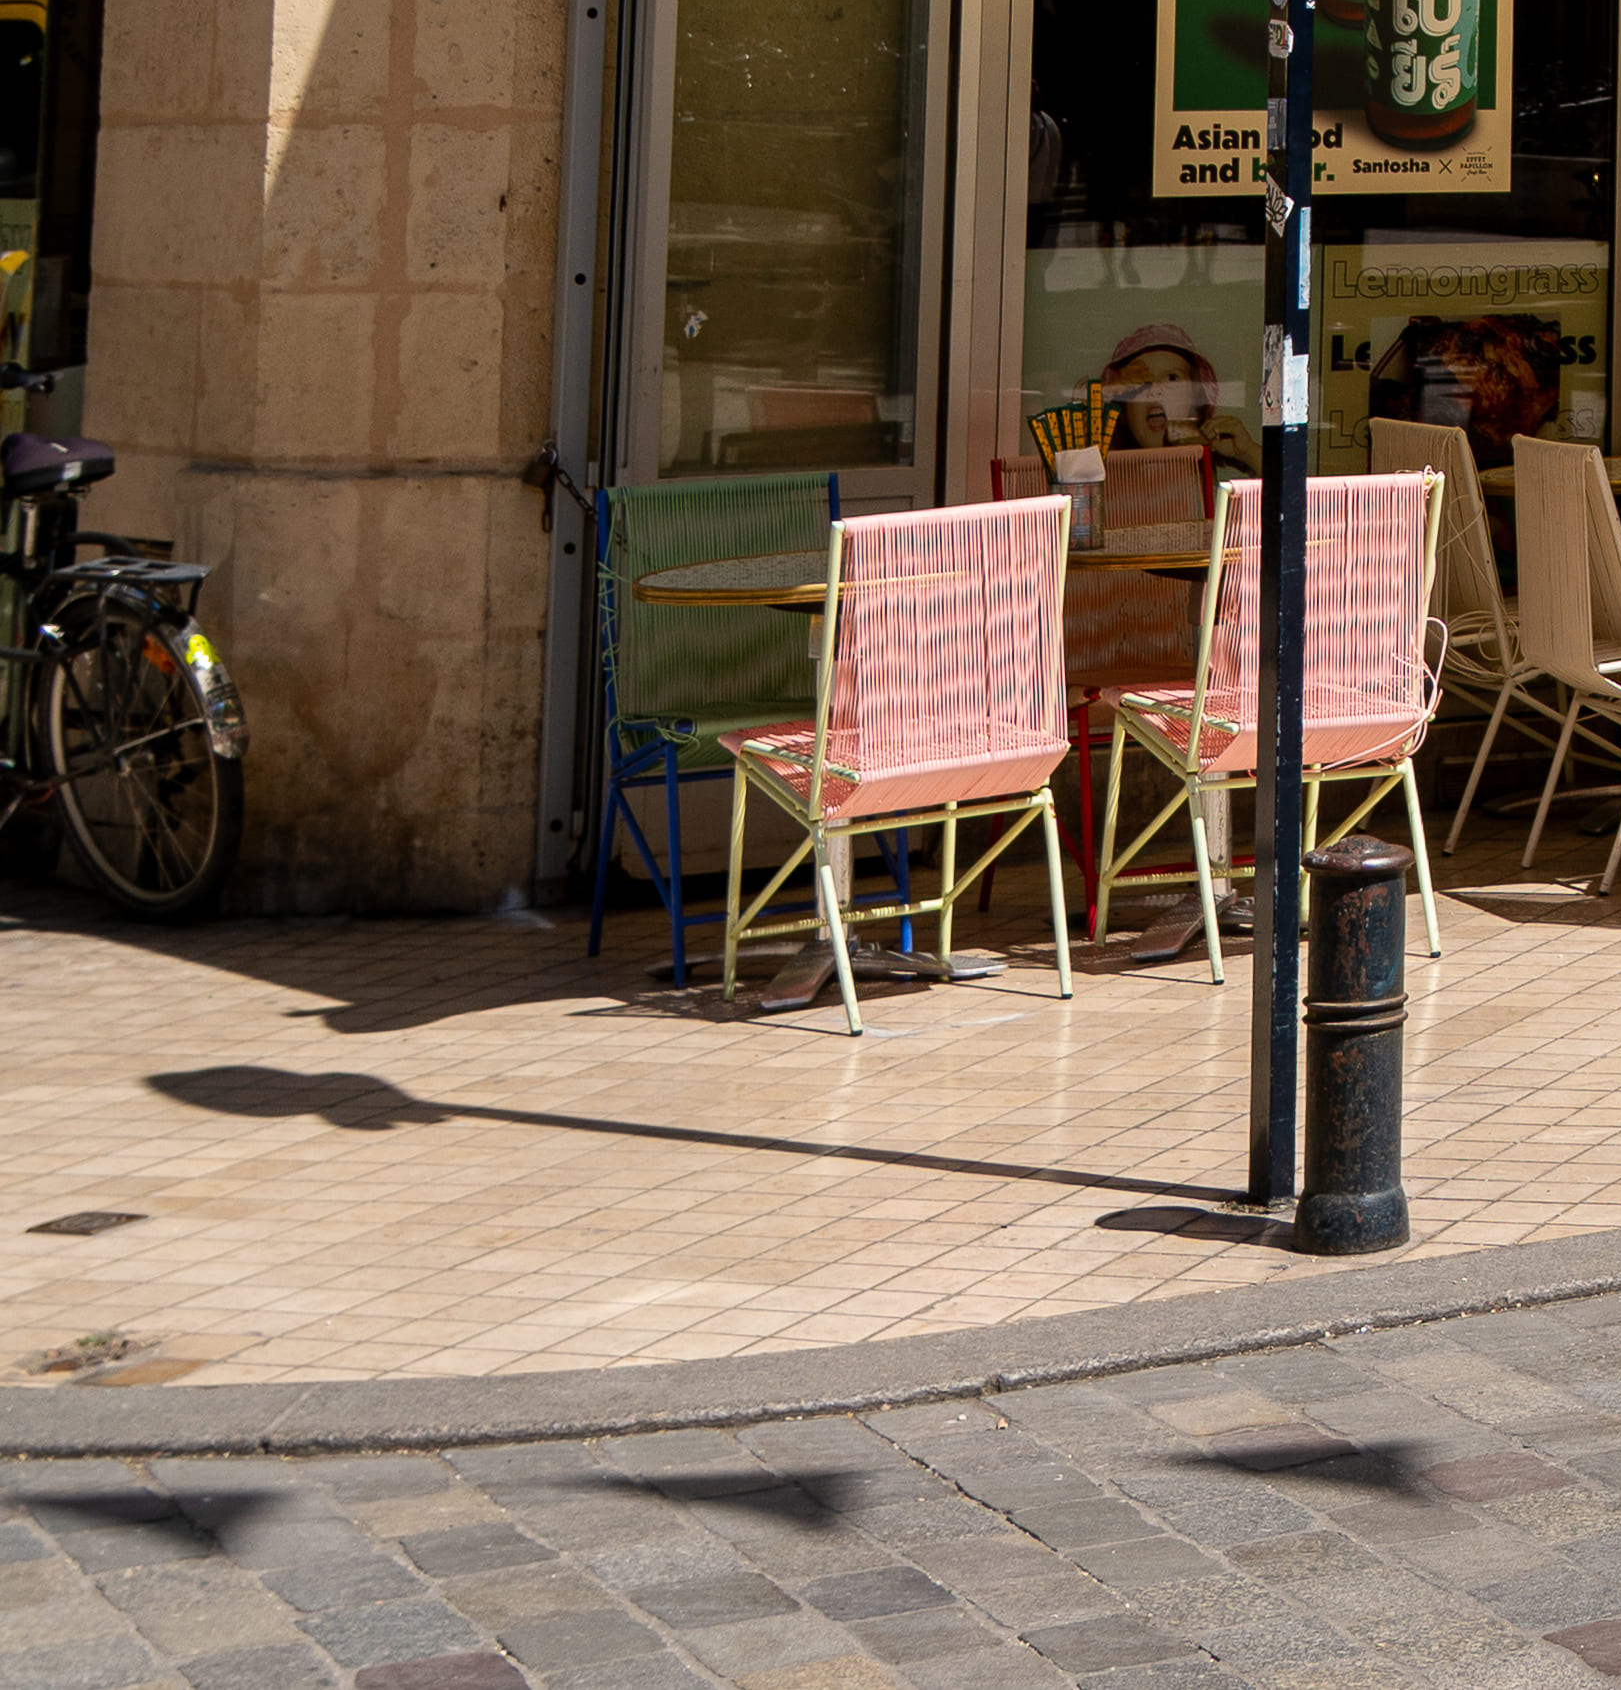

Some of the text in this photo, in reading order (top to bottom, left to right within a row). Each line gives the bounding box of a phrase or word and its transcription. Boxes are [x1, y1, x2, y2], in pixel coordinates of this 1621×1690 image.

[1172, 122, 1261, 150] Asian
[1178, 157, 1336, 184] and br.
[1352, 158, 1431, 174] Santosha
[1332, 260, 1600, 306] Lemongrass
